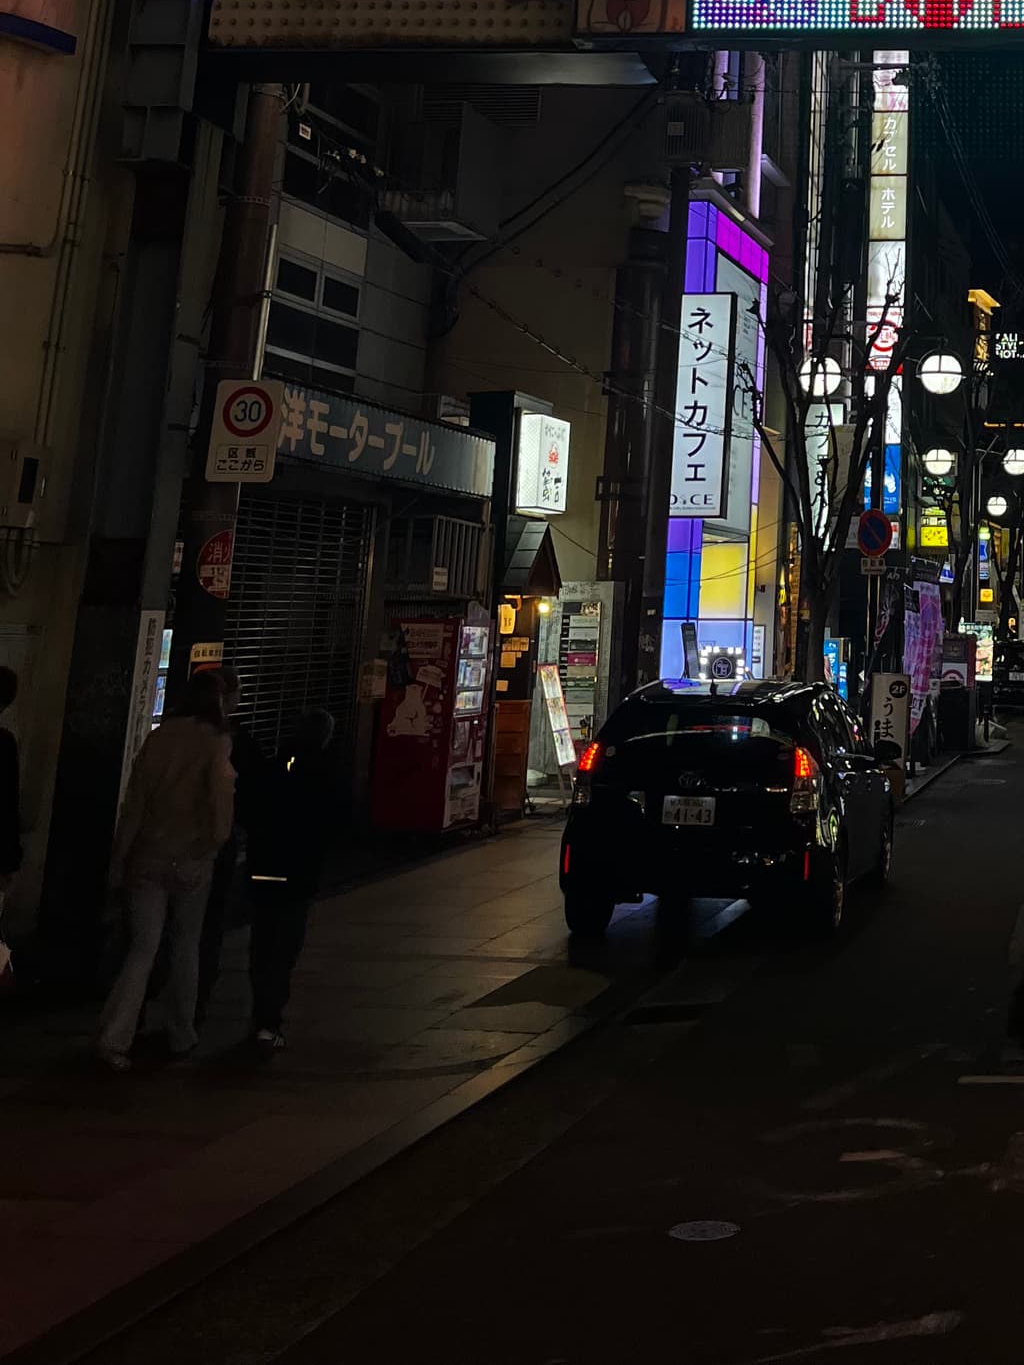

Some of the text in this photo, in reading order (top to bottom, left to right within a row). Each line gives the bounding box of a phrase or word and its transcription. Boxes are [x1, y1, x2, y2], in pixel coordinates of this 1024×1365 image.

[880, 187, 896, 229] ホテル
[234, 399, 262, 423] 30
[682, 307, 714, 482] ネットカフェ
[216, 459, 265, 472] ここから
